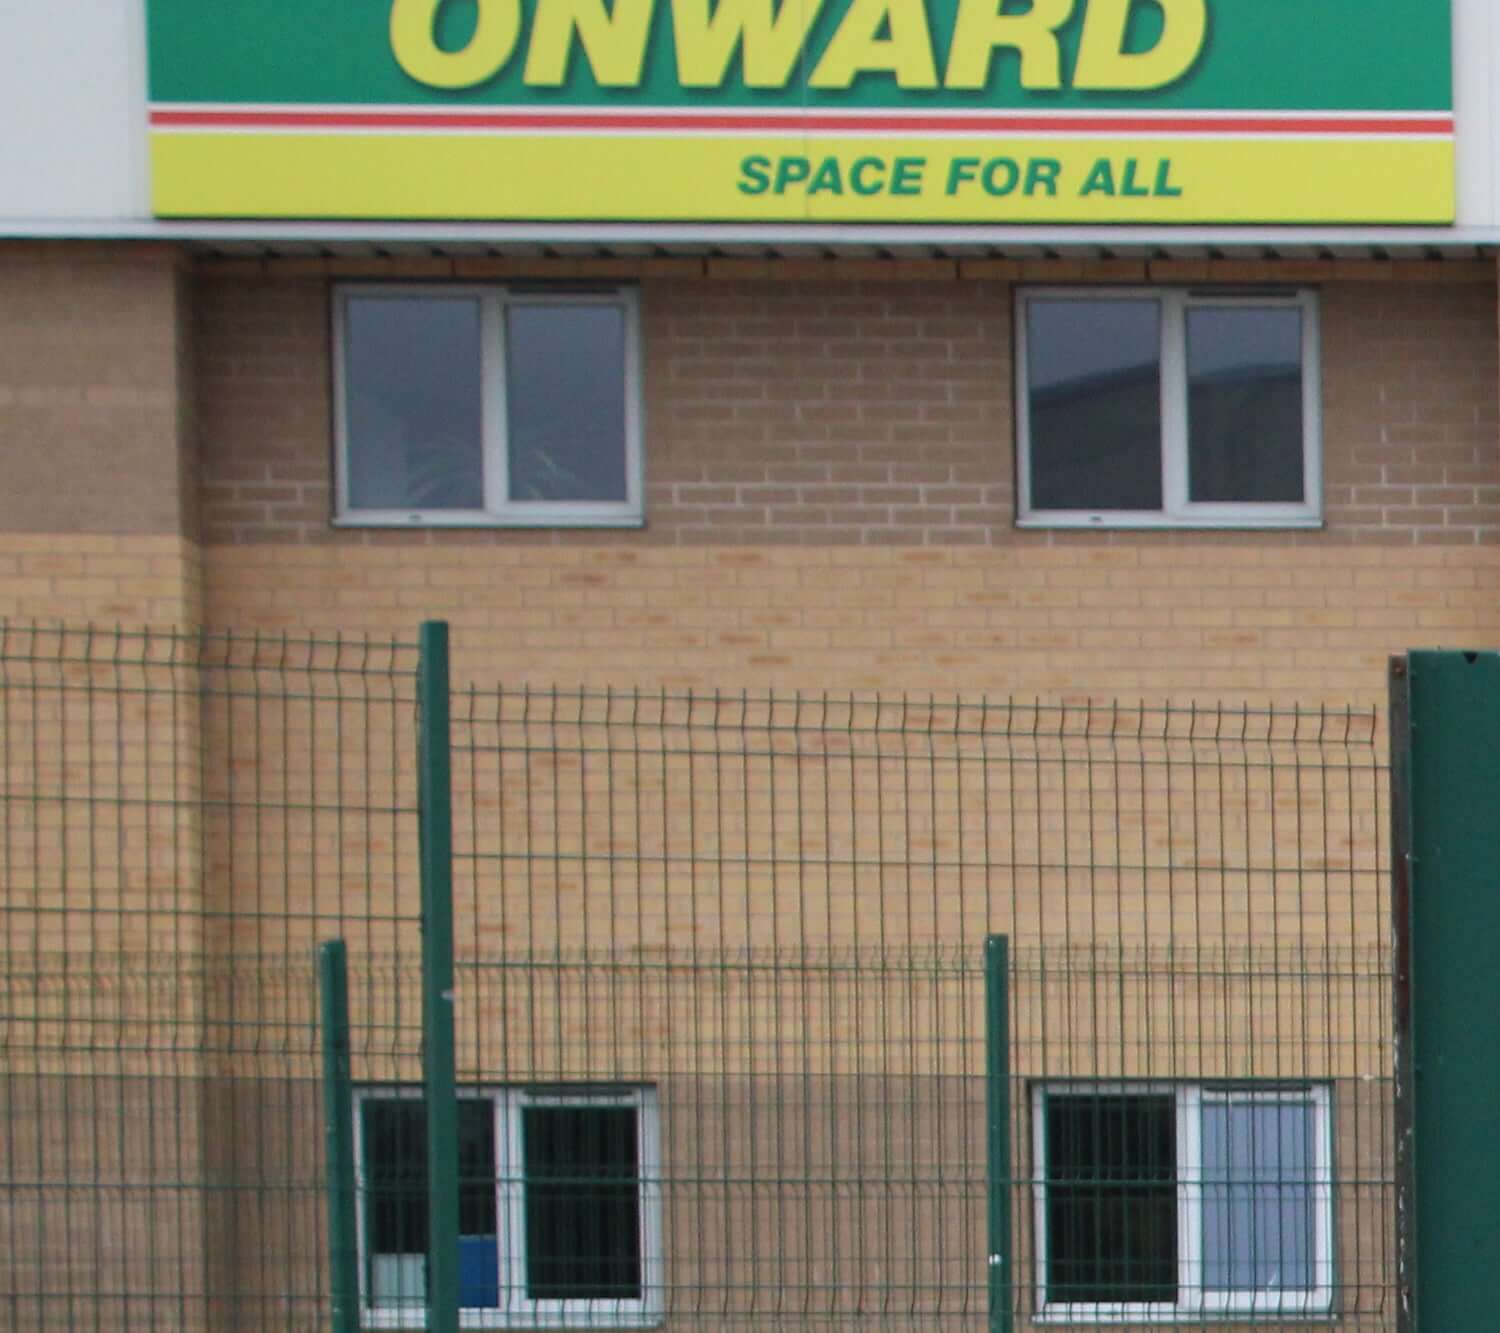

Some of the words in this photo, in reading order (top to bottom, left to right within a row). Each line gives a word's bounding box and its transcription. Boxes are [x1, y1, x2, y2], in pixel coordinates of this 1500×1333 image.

[388, 0, 1210, 92] ONWARD
[737, 154, 926, 199] SPACE
[945, 154, 1063, 199] FOR
[1077, 154, 1184, 199] ALL
